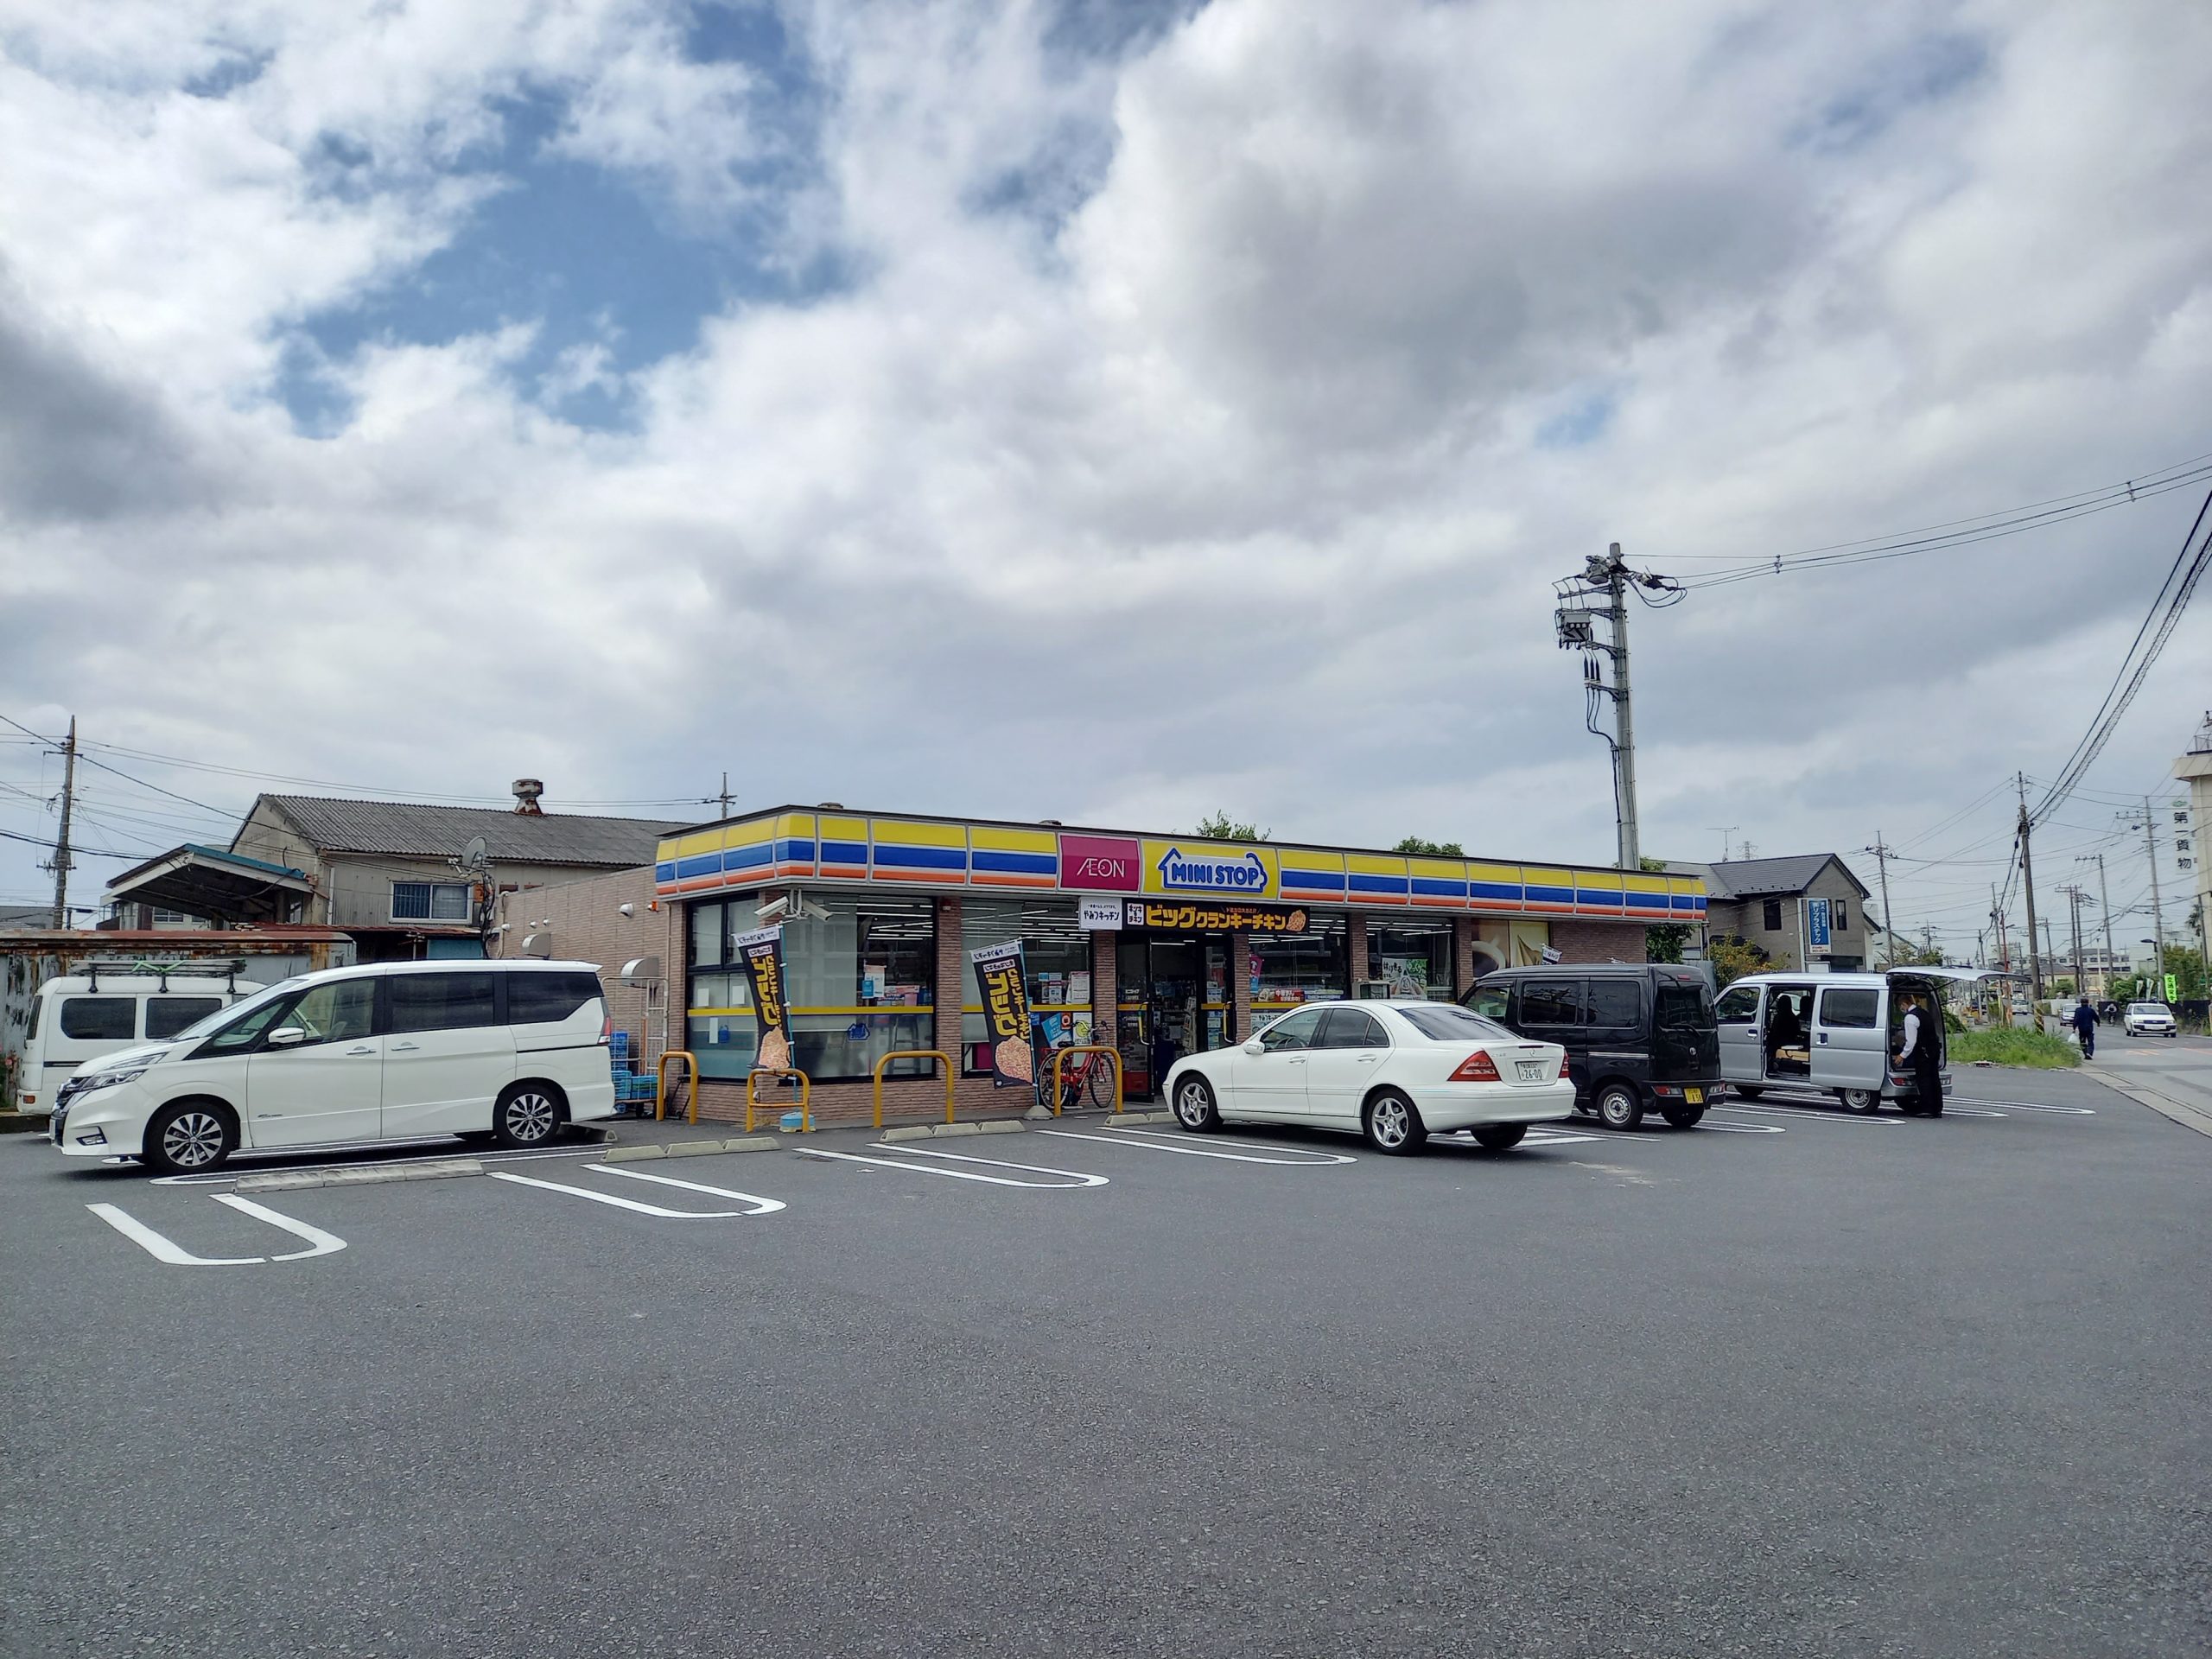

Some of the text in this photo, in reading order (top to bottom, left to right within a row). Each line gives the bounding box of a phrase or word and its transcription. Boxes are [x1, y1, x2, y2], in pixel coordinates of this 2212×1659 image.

[2174, 811, 2192, 869] 第一貨物
[1172, 863, 1261, 886] MINI STOP
[1146, 904, 1286, 930] ビッグクランキーチキン
